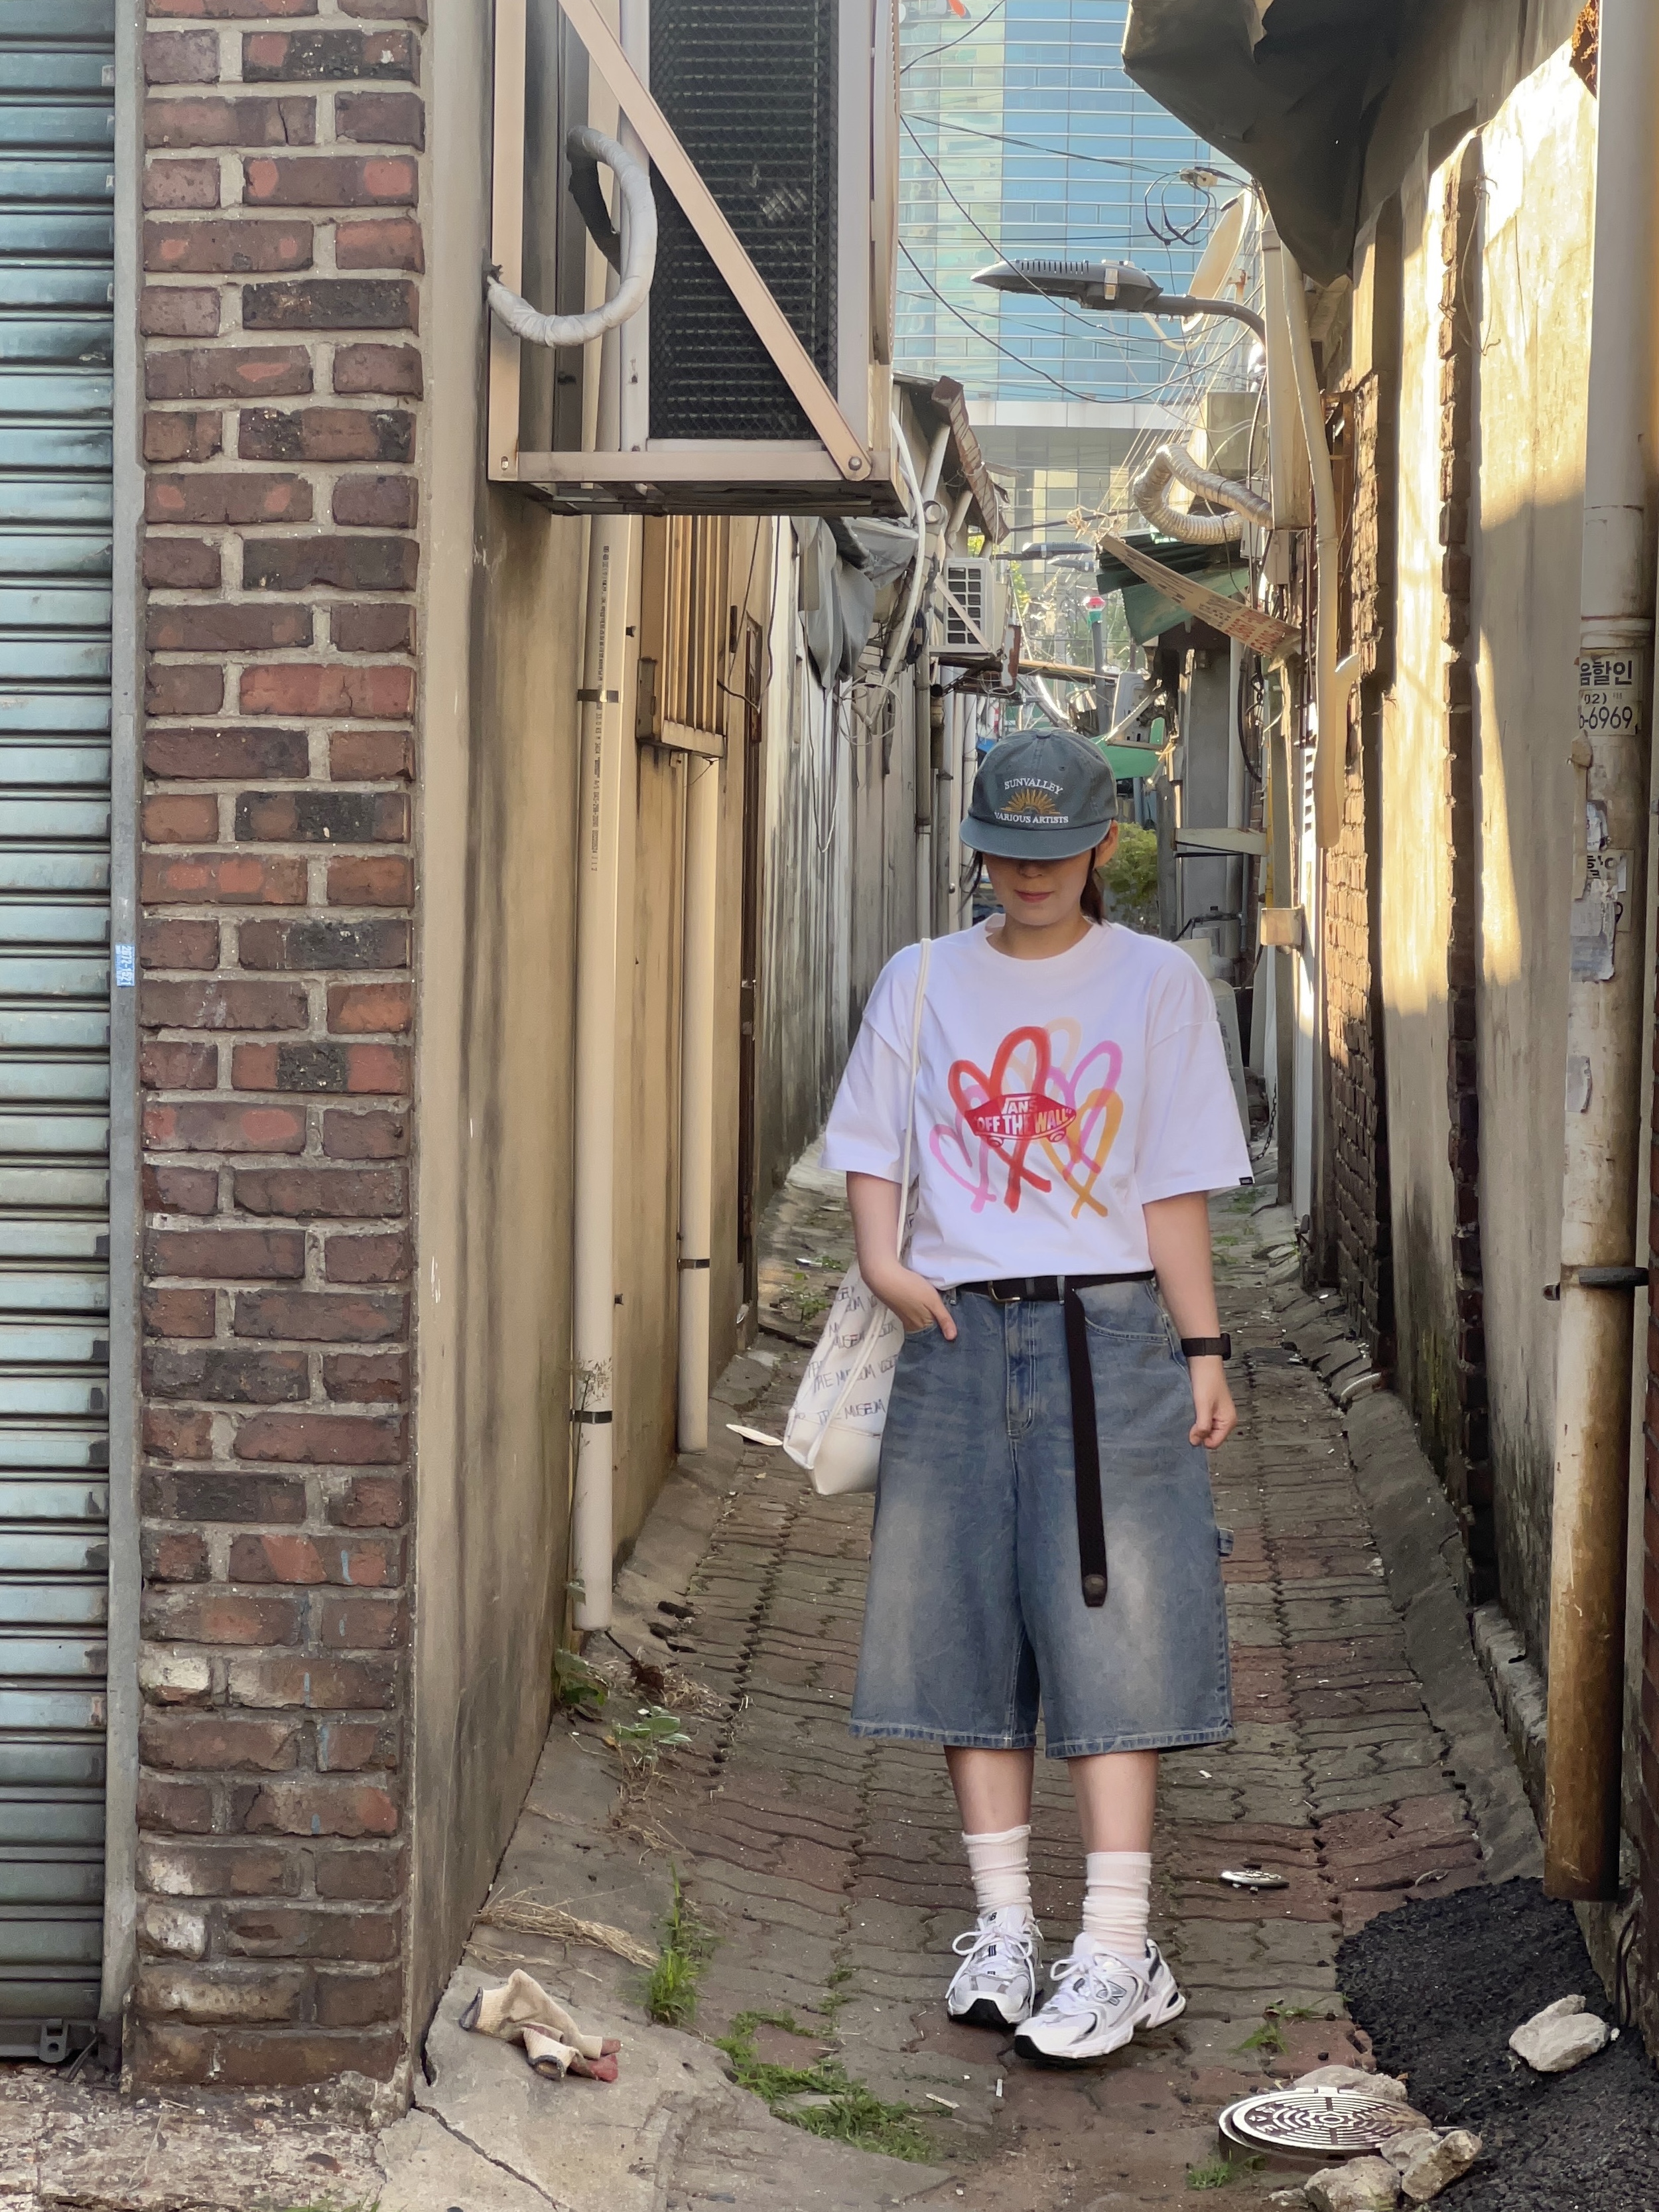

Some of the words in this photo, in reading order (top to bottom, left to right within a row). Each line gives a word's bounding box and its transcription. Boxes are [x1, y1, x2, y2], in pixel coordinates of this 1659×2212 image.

[1581, 660, 1632, 686] 음할인
[1004, 778, 1063, 795] SUNVALLEY
[994, 811, 1031, 823] VARIOUS
